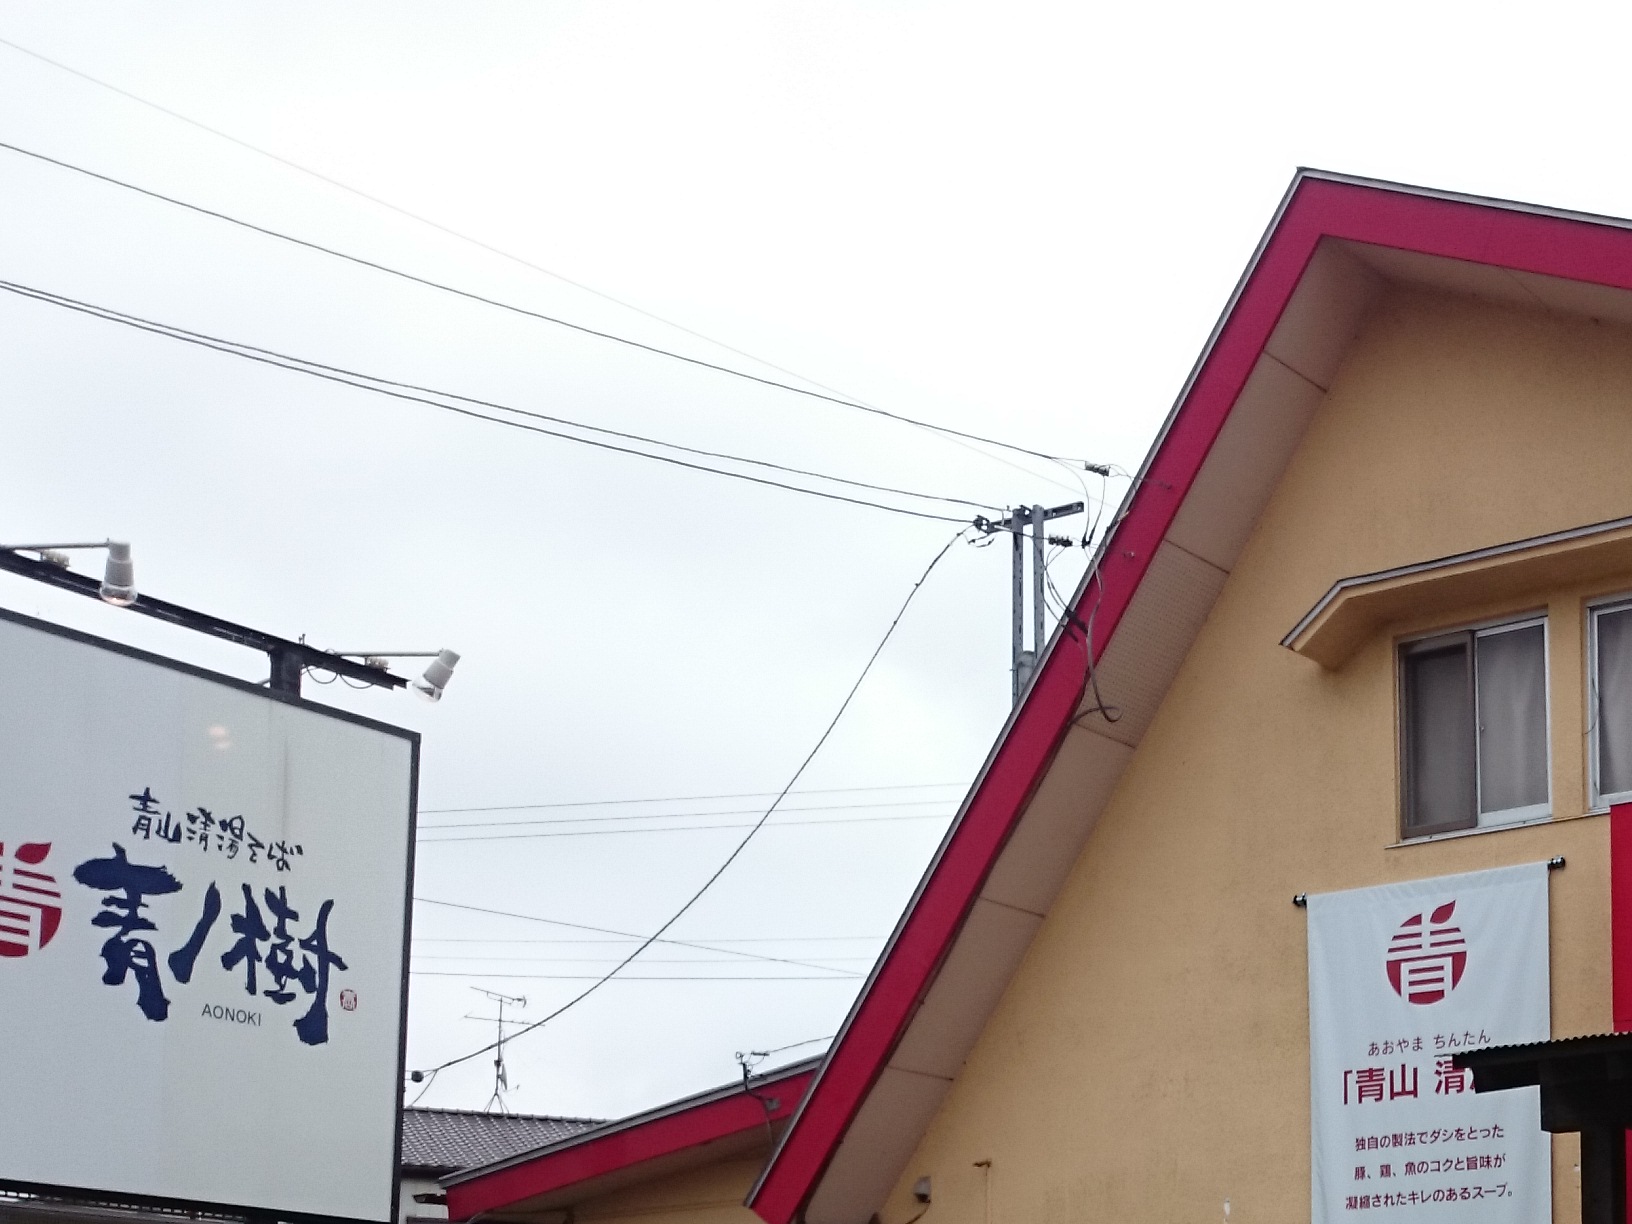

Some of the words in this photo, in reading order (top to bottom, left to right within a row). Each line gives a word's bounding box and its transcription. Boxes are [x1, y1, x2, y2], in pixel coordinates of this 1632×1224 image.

[201, 1003, 262, 1026] AONOKI
[1368, 1036, 1424, 1057] あおやま
[1433, 1029, 1491, 1050] ちんたん
[1343, 1063, 1419, 1106] 「青山
[1433, 1059, 1476, 1095] 清
[1355, 1124, 1505, 1152] 独自の製法でダシをとった
[1345, 1181, 1513, 1211] 凝縮されたキレのあるスープ。
